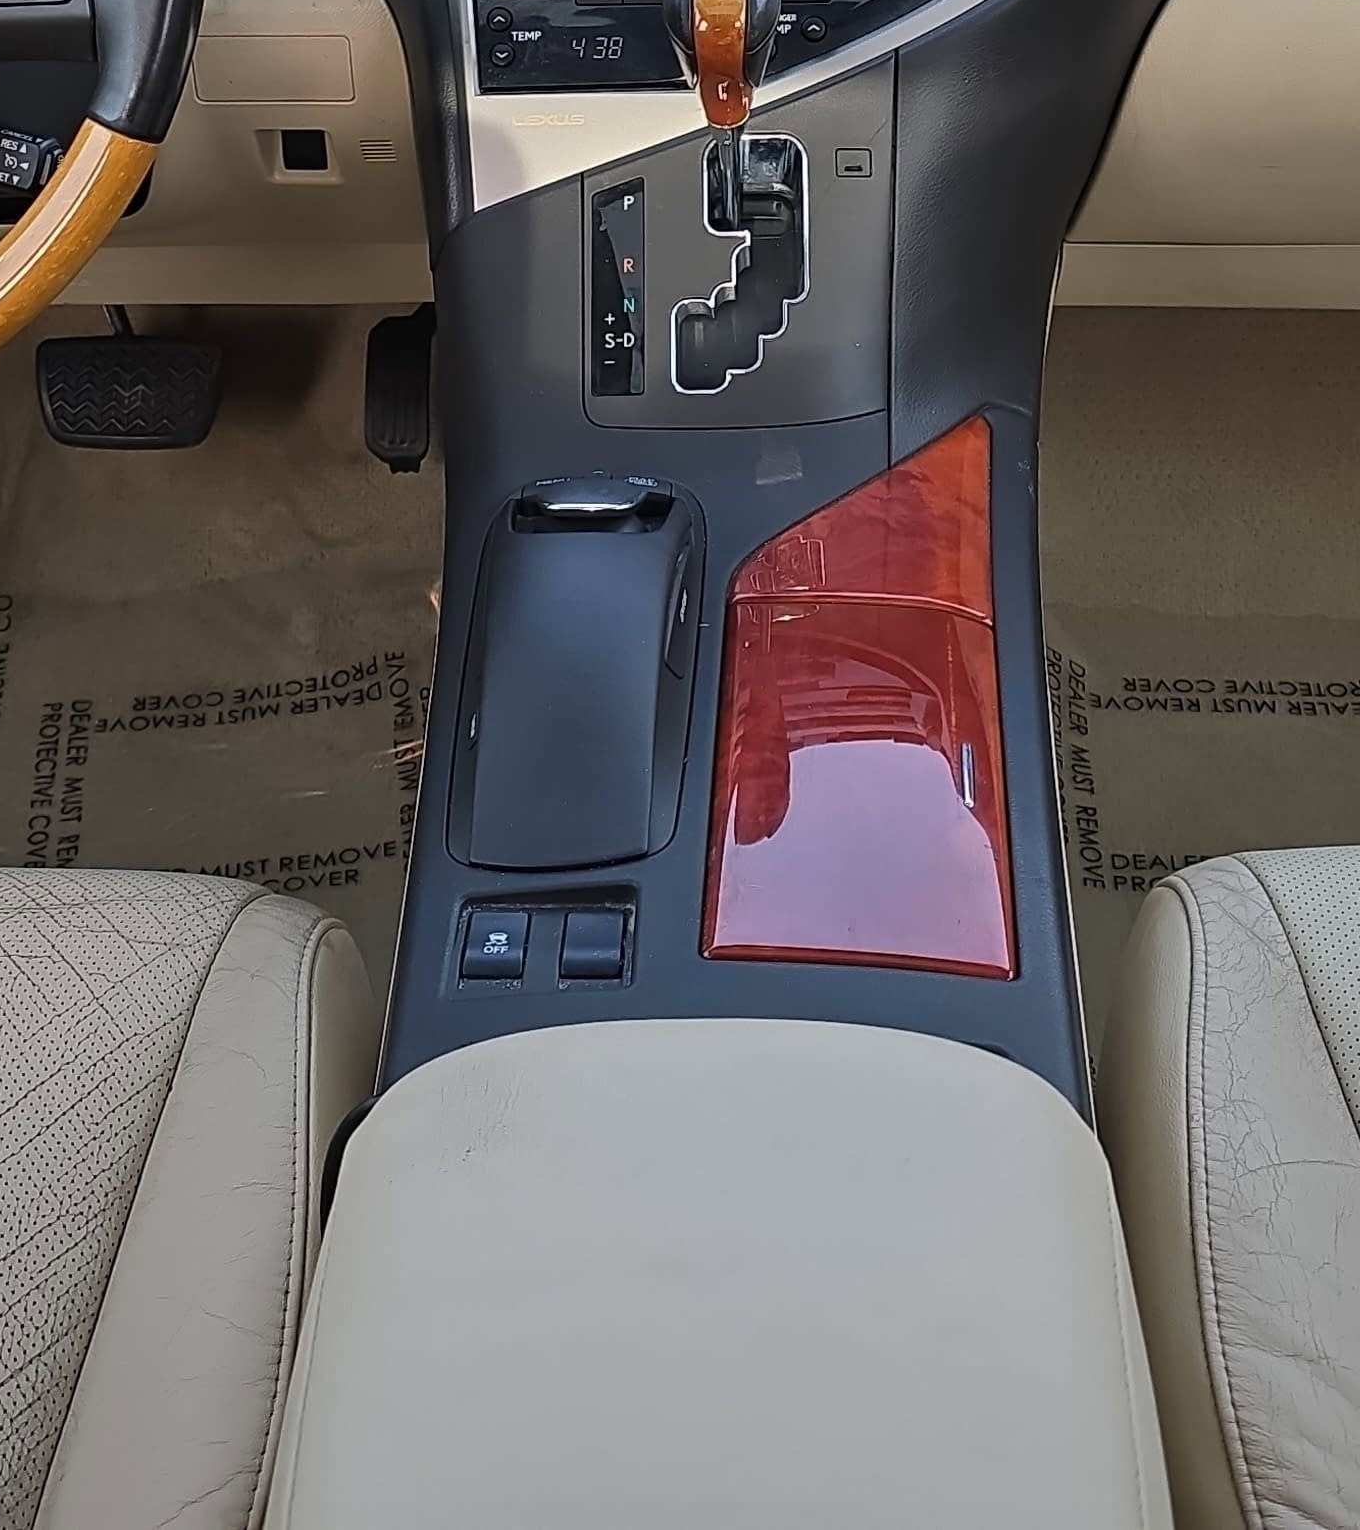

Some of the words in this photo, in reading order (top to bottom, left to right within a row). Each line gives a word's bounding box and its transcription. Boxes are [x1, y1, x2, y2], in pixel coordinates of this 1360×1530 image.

[511, 31, 542, 42] TEMP
[512, 114, 585, 126] LEXUS
[623, 195, 635, 211] P
[623, 257, 635, 273] R
[623, 298, 635, 313] N
[233, 655, 378, 704] PROTECTIVE
[1122, 677, 1217, 693] COVER
[131, 691, 224, 711] COVER
[289, 681, 382, 716] DEALER
[384, 651, 414, 733] EMOVE
[1067, 660, 1089, 736] DEALER
[1088, 692, 1202, 711] REMOVE
[215, 703, 281, 725] MUST
[1210, 697, 1277, 713] MUST
[65, 699, 93, 767] DEALER
[94, 713, 207, 733] REMOVE
[29, 701, 64, 810] PROTECTIVE
[1070, 743, 1095, 796] MUST
[58, 777, 85, 823] MUST
[279, 840, 397, 872] REMOVE
[1075, 804, 1106, 890] REMOVE
[1111, 853, 1214, 870] DEALE
[483, 945, 509, 955] OFF
